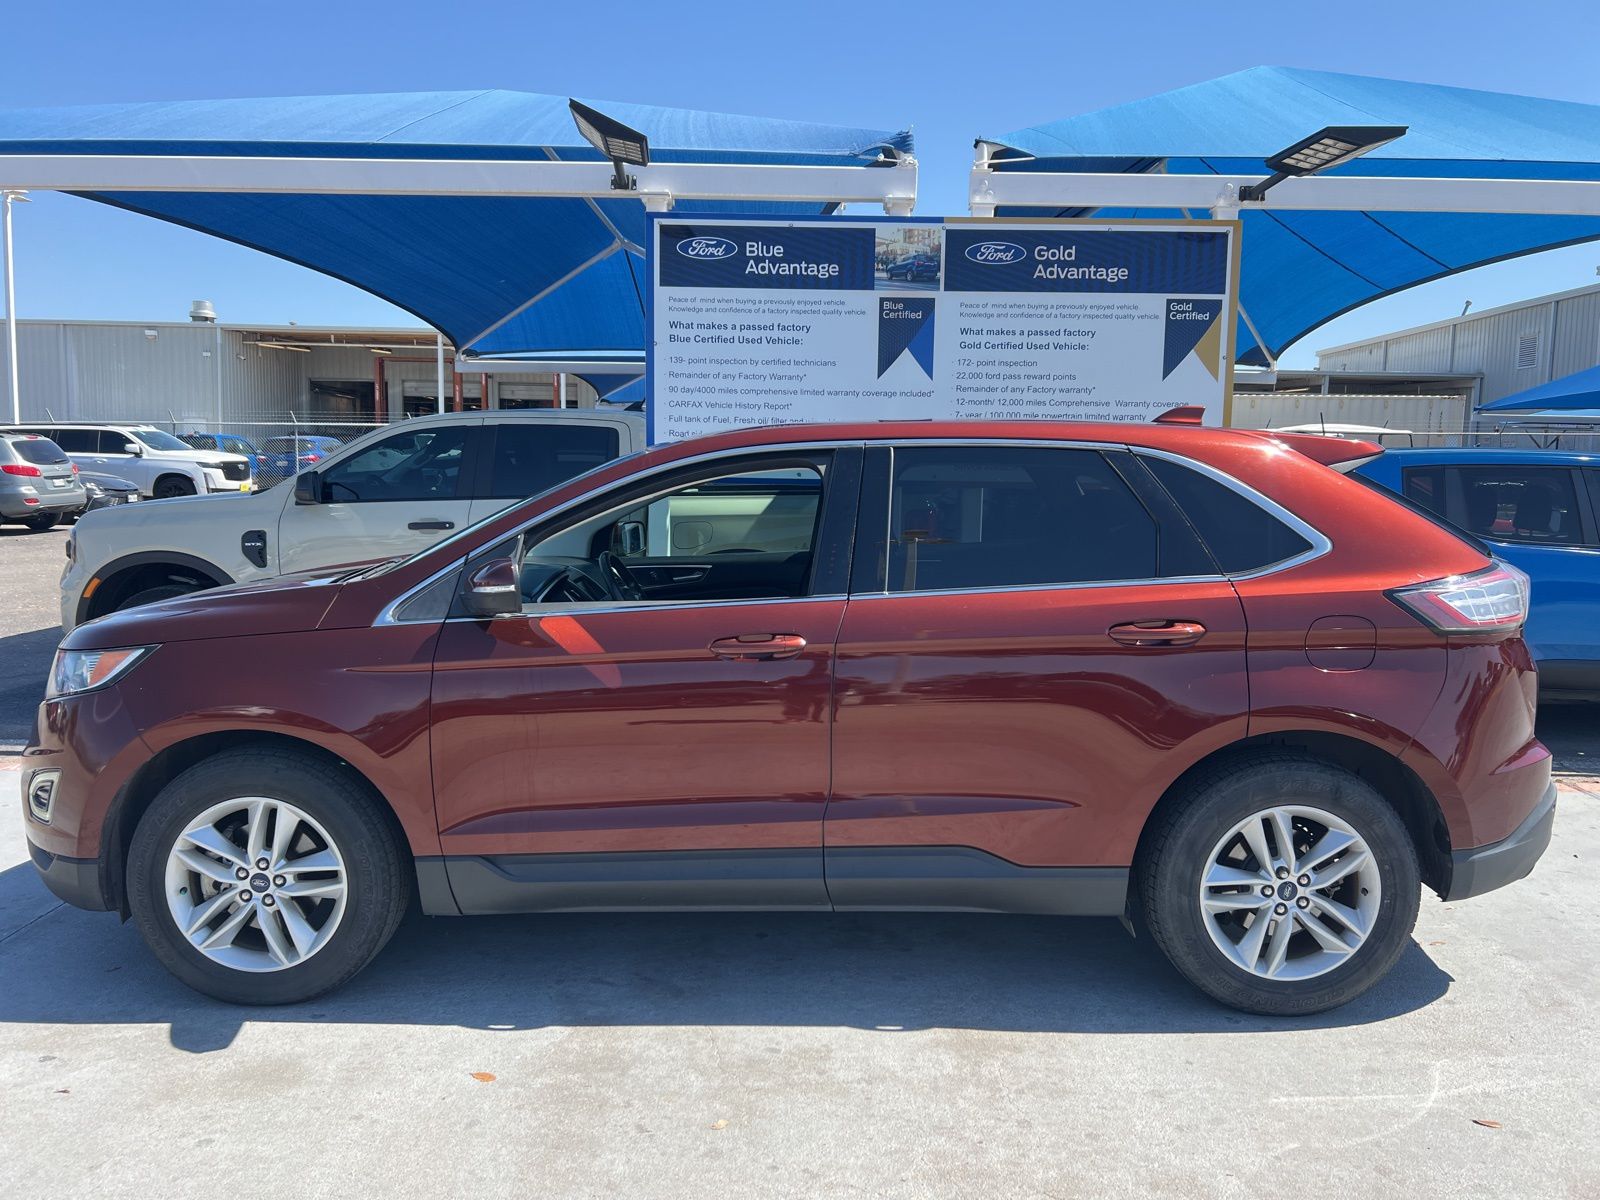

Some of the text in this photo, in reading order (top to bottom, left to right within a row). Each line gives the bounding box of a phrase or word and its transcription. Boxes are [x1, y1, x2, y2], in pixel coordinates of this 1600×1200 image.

[688, 239, 726, 256] Ford
[745, 242, 784, 257] Blue
[976, 244, 1015, 261] Ford
[1034, 246, 1076, 261] Gold
[745, 259, 840, 279] Advantage
[1033, 264, 1129, 283] Advantage
[735, 298, 756, 306] buying
[763, 298, 795, 306] previously
[796, 299, 822, 307] enjoyed
[883, 301, 904, 310] Blue
[1027, 303, 1049, 311] buying
[1055, 303, 1088, 311] previously
[1089, 304, 1115, 312] enjoyed
[1170, 303, 1192, 311] Gold
[668, 305, 704, 314] Knowledge
[718, 306, 752, 314] confidence
[767, 307, 789, 316] factory
[790, 308, 820, 317] inspected
[821, 308, 843, 317] quality
[882, 310, 922, 319] Certified
[959, 311, 995, 320] Knowledge
[1059, 312, 1081, 321] factory
[1082, 313, 1113, 321] inspected
[1114, 313, 1136, 321] quality
[1169, 311, 1210, 321] Certified
[668, 320, 811, 334] What makes a passed factory
[959, 327, 984, 337] What
[986, 328, 1017, 337] makes
[1027, 329, 1061, 339] passed
[1063, 328, 1096, 339] factory
[669, 334, 804, 346] Blue Certified Used Vehicle:
[959, 341, 1089, 351] Gold Certified Used Vehicle:
[669, 356, 837, 367] 139- point inspection by certified technicians
[957, 358, 1038, 368] 172- point inspection
[668, 370, 711, 379] Remainder
[712, 371, 721, 379] of
[721, 373, 736, 381] any
[738, 372, 767, 382] Factory
[985, 372, 1001, 380] ford
[1002, 374, 1022, 382] pass
[1023, 373, 1051, 381] reward
[1052, 373, 1077, 382] points
[668, 385, 679, 393] 90
[680, 386, 716, 395] day/4000
[717, 387, 739, 395] miles
[740, 387, 798, 396] comprehensive
[800, 388, 825, 397] limited
[826, 390, 860, 399] warranty
[861, 390, 898, 399] coverage
[956, 384, 999, 393] Remainder
[1000, 385, 1009, 393] of
[1010, 387, 1025, 395] any
[1027, 386, 1057, 395] Factory
[668, 400, 703, 408] CARFAX
[705, 401, 733, 409] Vehicle
[734, 402, 762, 411] History
[1025, 399, 1047, 407] miles
[1048, 399, 1111, 408] Comprehensive
[1115, 400, 1151, 409] Warranty
[668, 414, 683, 423] Full
[684, 415, 702, 423] tank
[702, 415, 711, 424] of
[733, 416, 756, 424] Fresh
[1023, 411, 1040, 419] mile
[1084, 413, 1110, 421] limited
[1112, 414, 1147, 422] warranty
